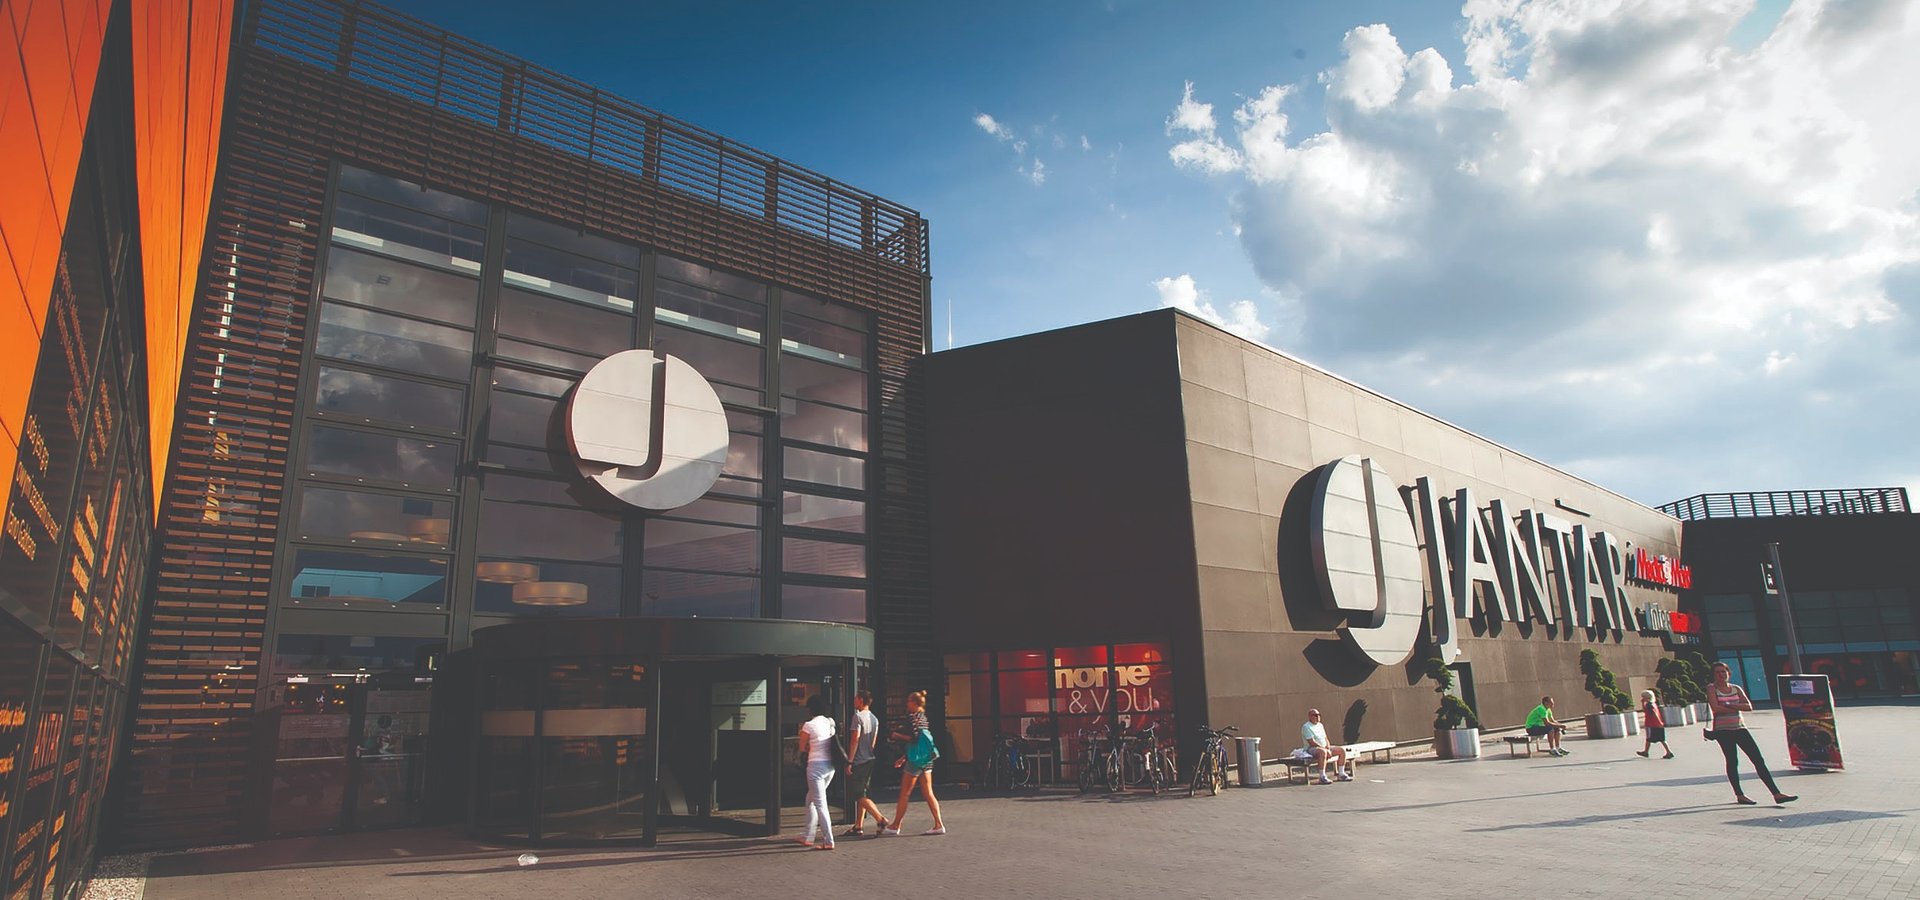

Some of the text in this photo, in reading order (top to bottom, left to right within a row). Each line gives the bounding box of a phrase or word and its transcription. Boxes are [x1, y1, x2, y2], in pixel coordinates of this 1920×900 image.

[1417, 476, 1640, 665] JANTAR
[1054, 658, 1151, 689] home
[1069, 687, 1153, 724] & you
